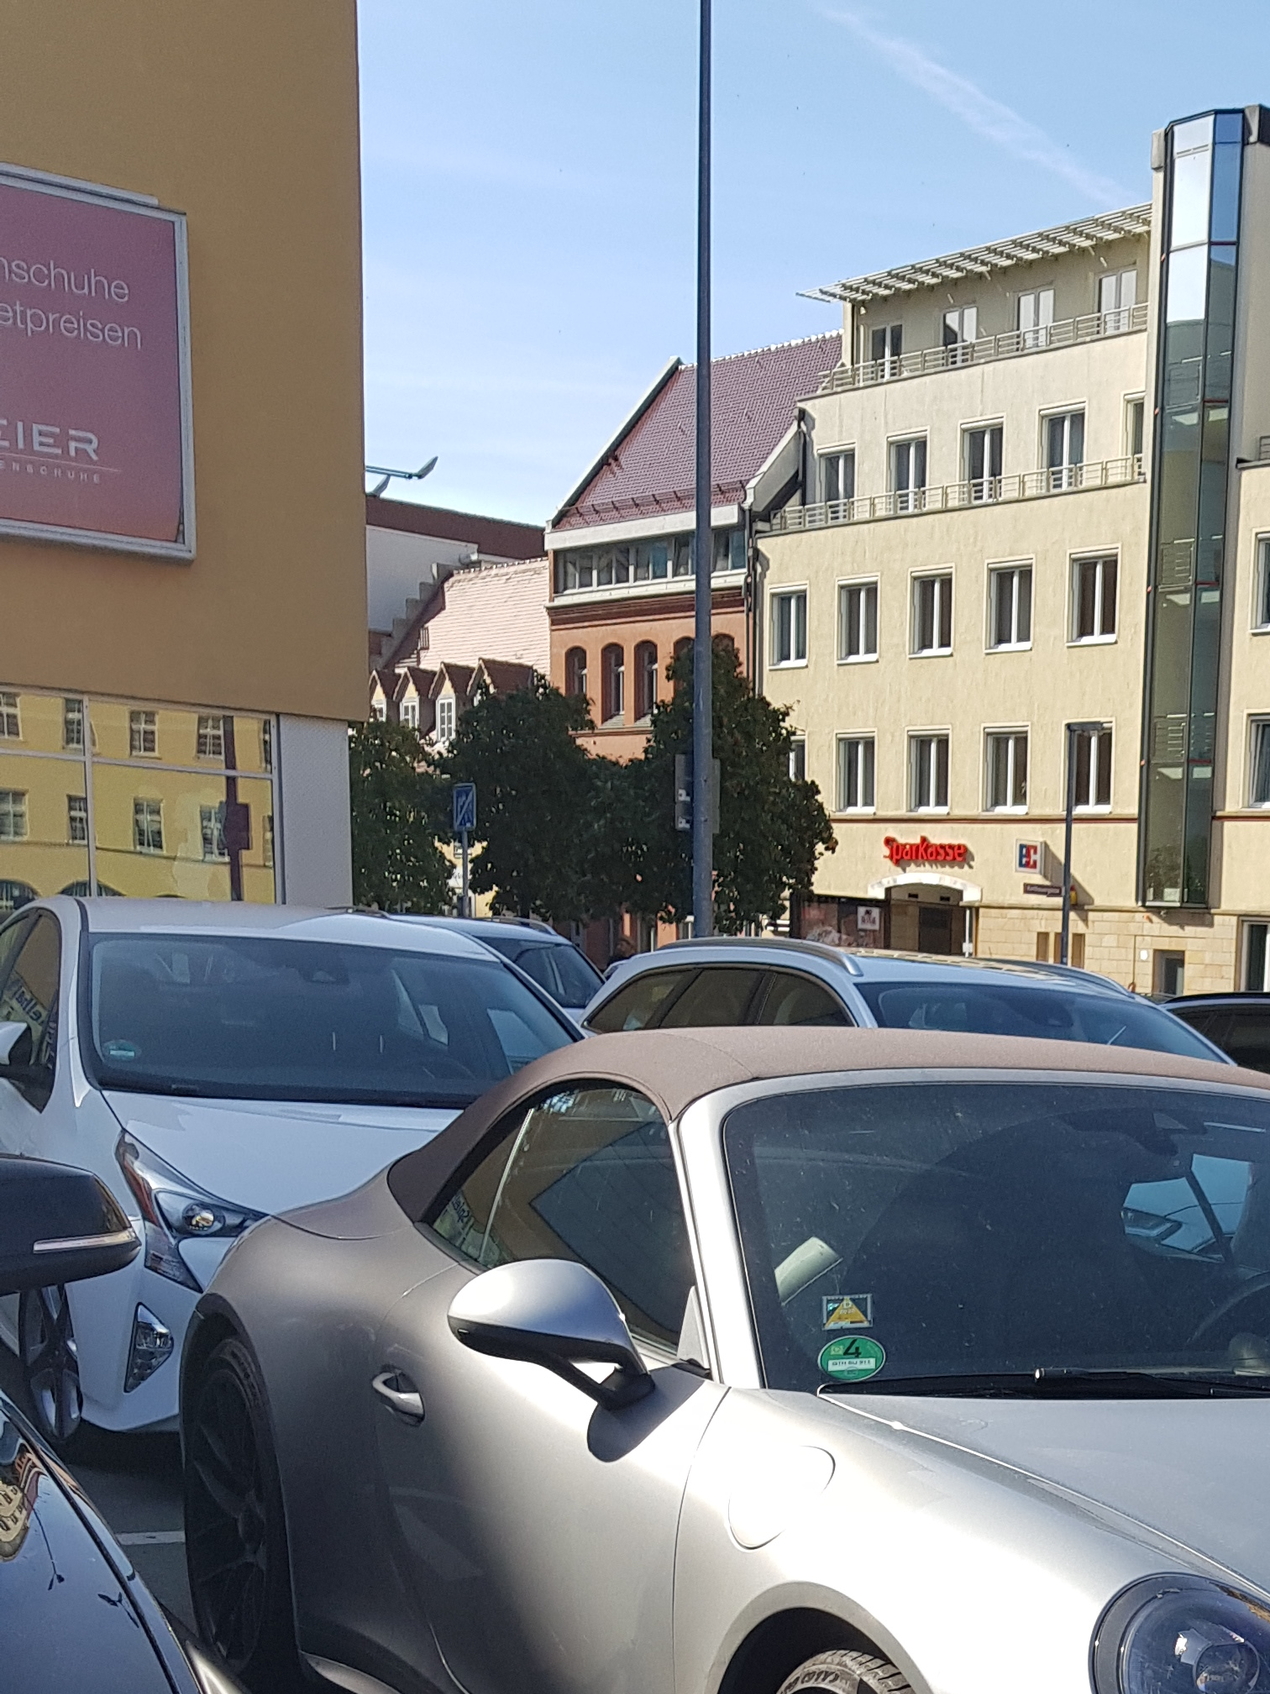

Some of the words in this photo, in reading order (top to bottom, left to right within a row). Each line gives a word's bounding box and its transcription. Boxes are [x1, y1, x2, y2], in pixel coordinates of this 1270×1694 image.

[0, 300, 142, 350] etpreisen
[883, 835, 967, 867] Sparkasse
[843, 1338, 862, 1358] 4
